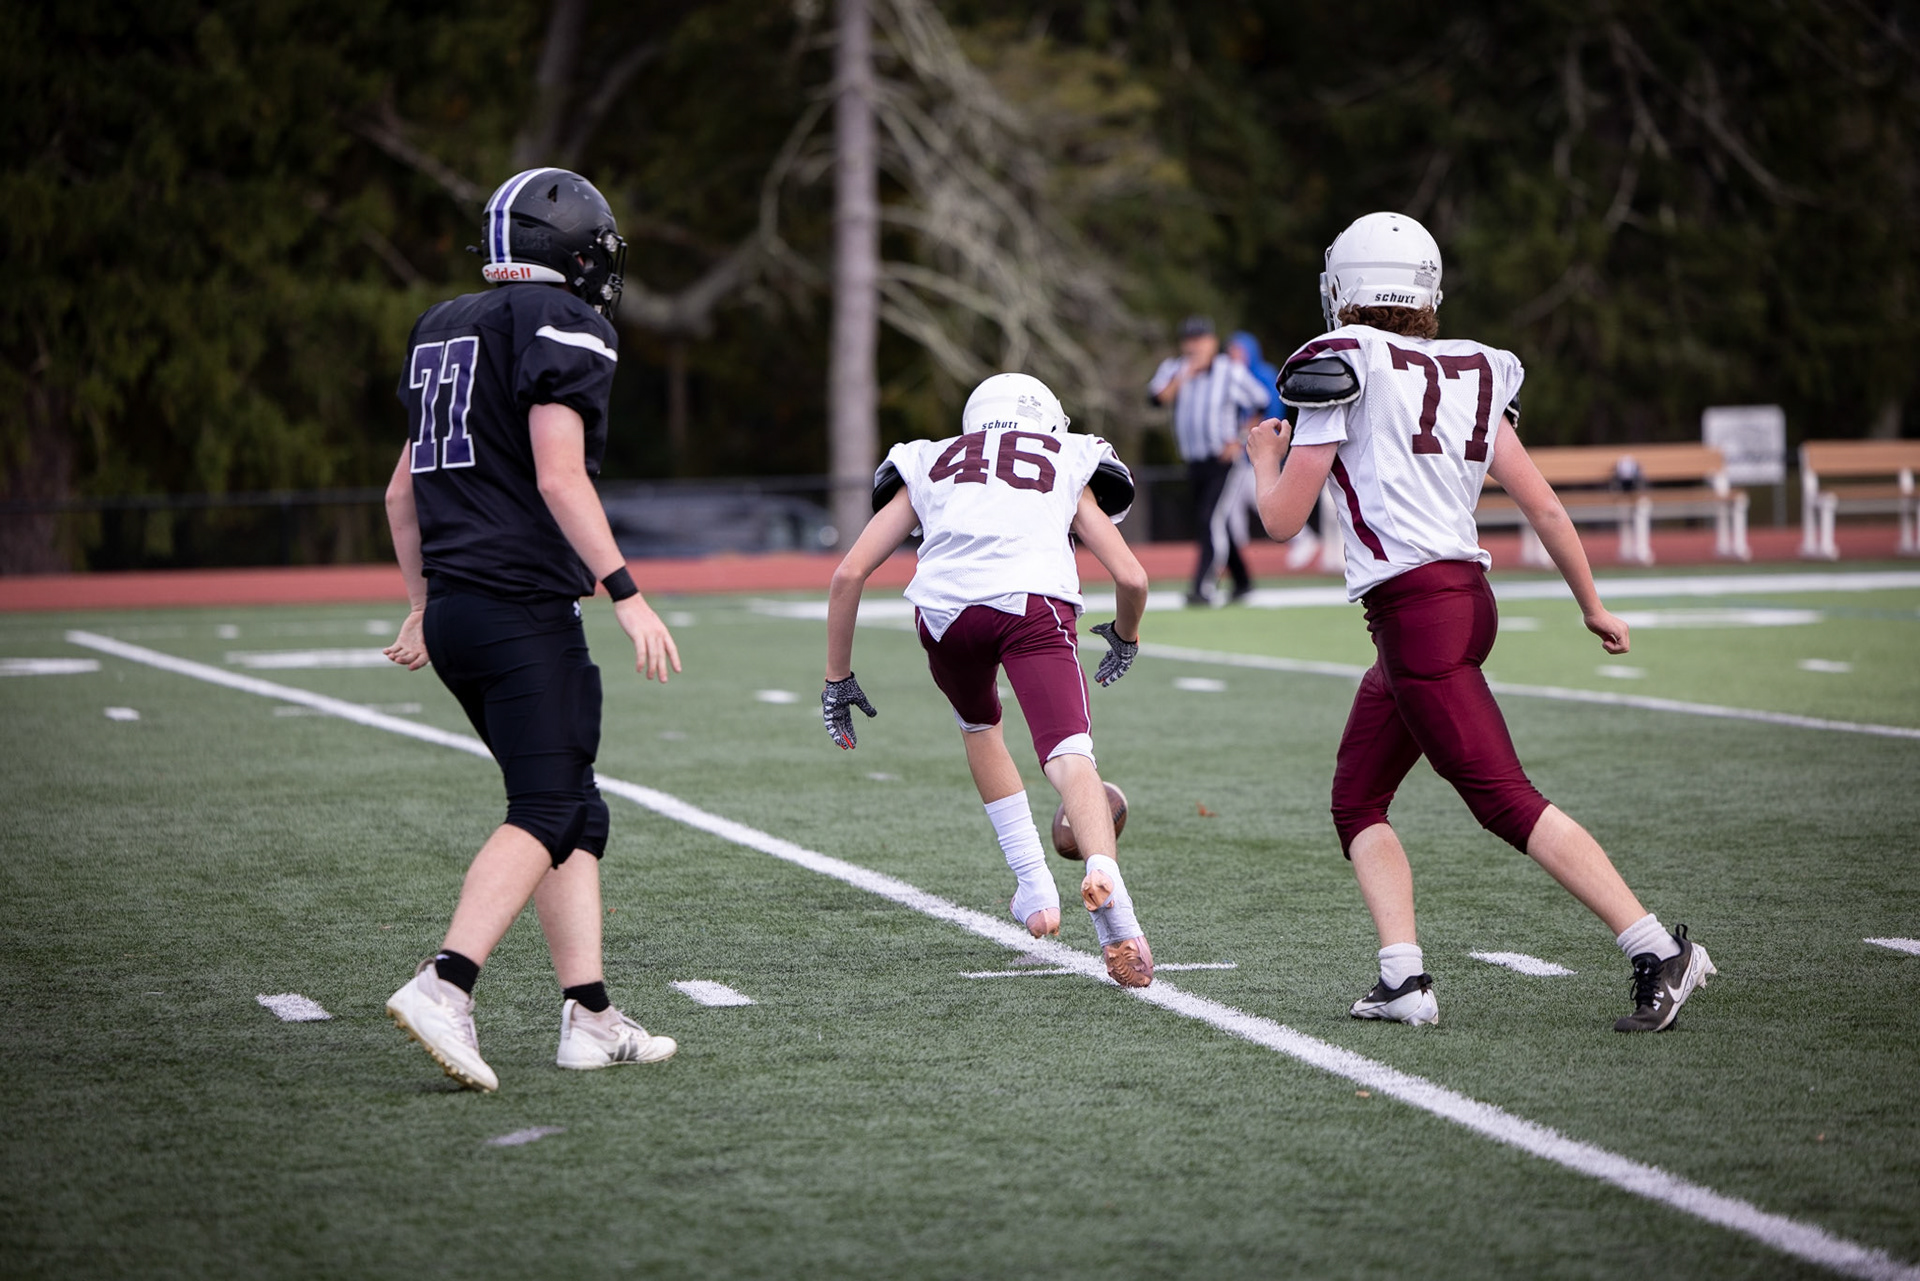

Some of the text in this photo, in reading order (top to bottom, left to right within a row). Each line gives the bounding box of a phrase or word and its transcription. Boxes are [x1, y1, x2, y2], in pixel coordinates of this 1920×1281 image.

[409, 335, 479, 474] 77
[928, 430, 1062, 494] 46
[1386, 341, 1493, 463] 77
